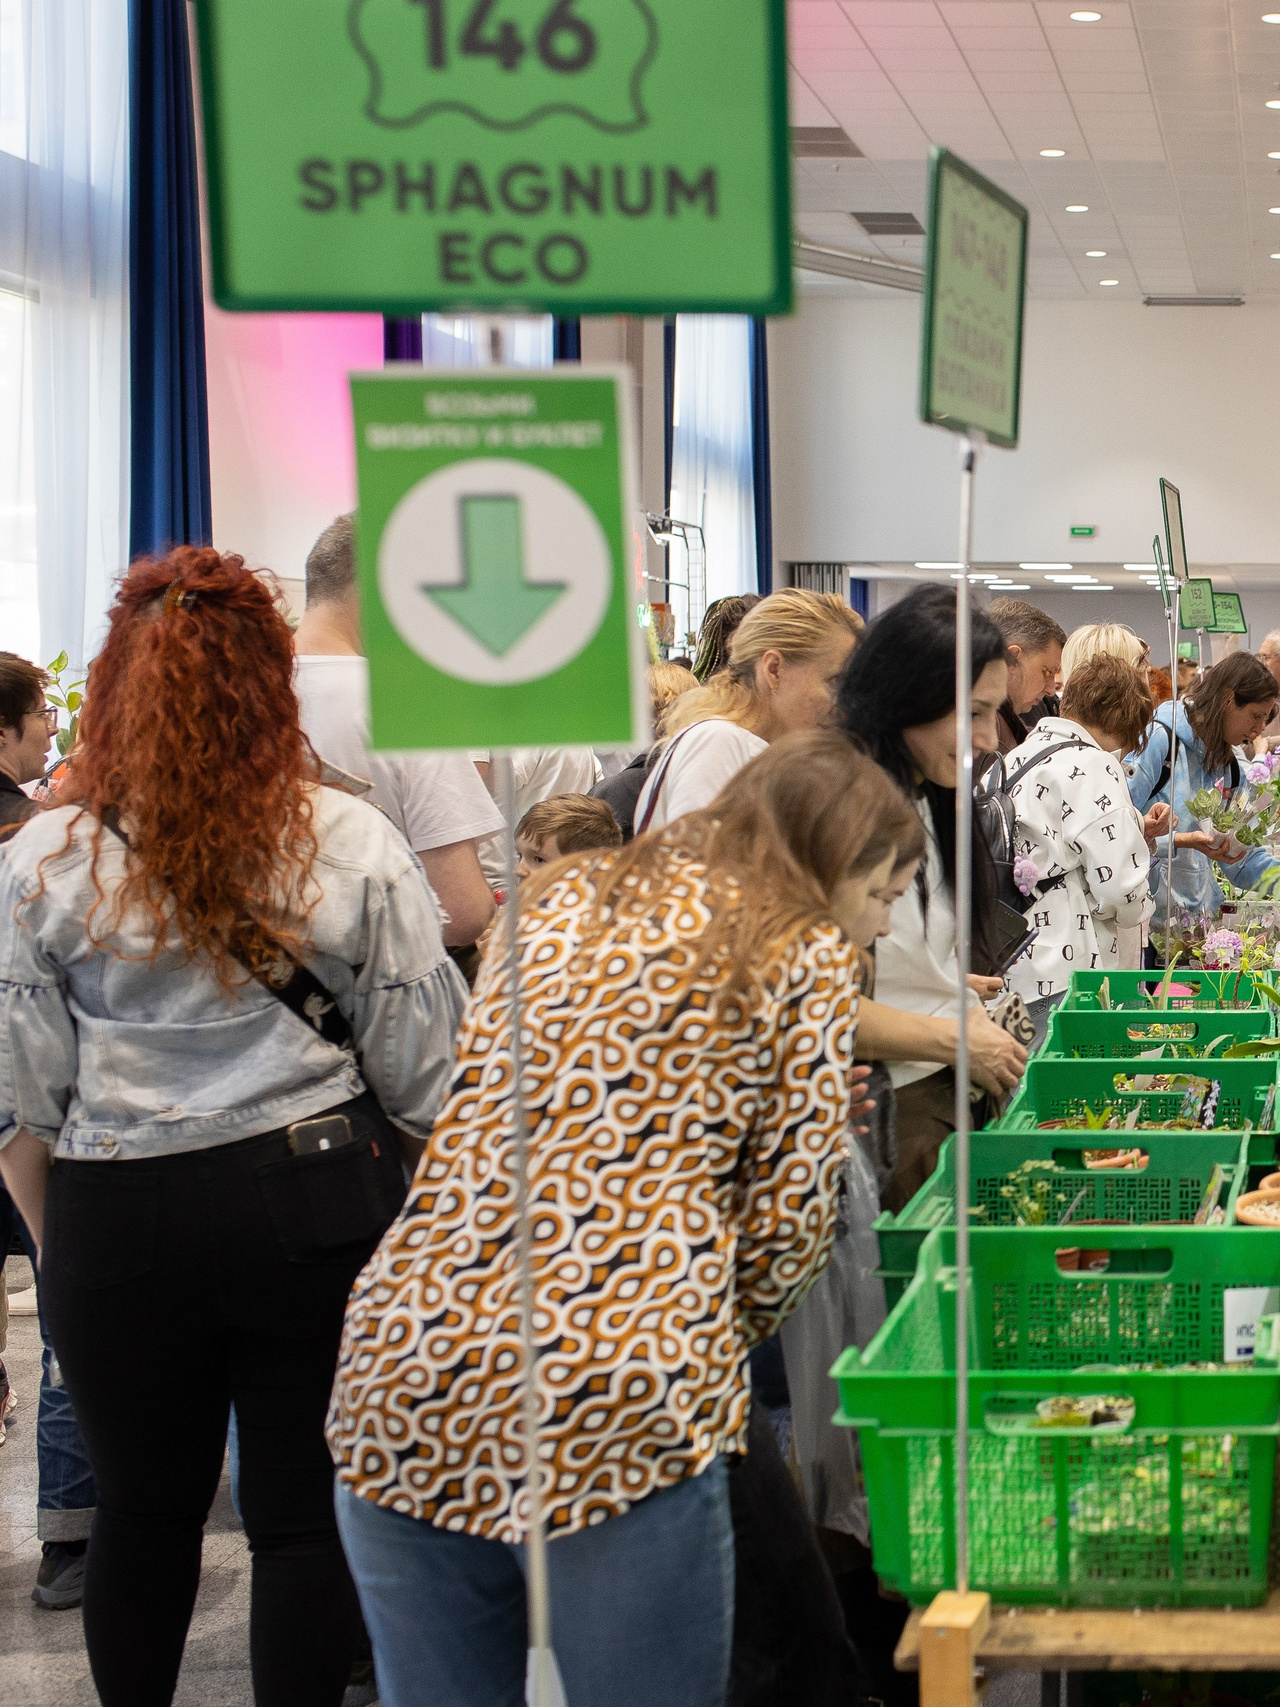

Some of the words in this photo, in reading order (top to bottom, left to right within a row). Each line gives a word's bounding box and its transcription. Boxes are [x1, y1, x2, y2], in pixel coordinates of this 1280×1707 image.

[414, 0, 598, 73] 146
[299, 156, 720, 219] SPHAGNUM
[439, 232, 590, 285] ECO
[1101, 824, 1116, 841] T
[1095, 866, 1113, 883] D
[1034, 911, 1051, 928] H
[1076, 914, 1089, 931] T
[1062, 945, 1074, 961] O
[1036, 981, 1054, 997] U
